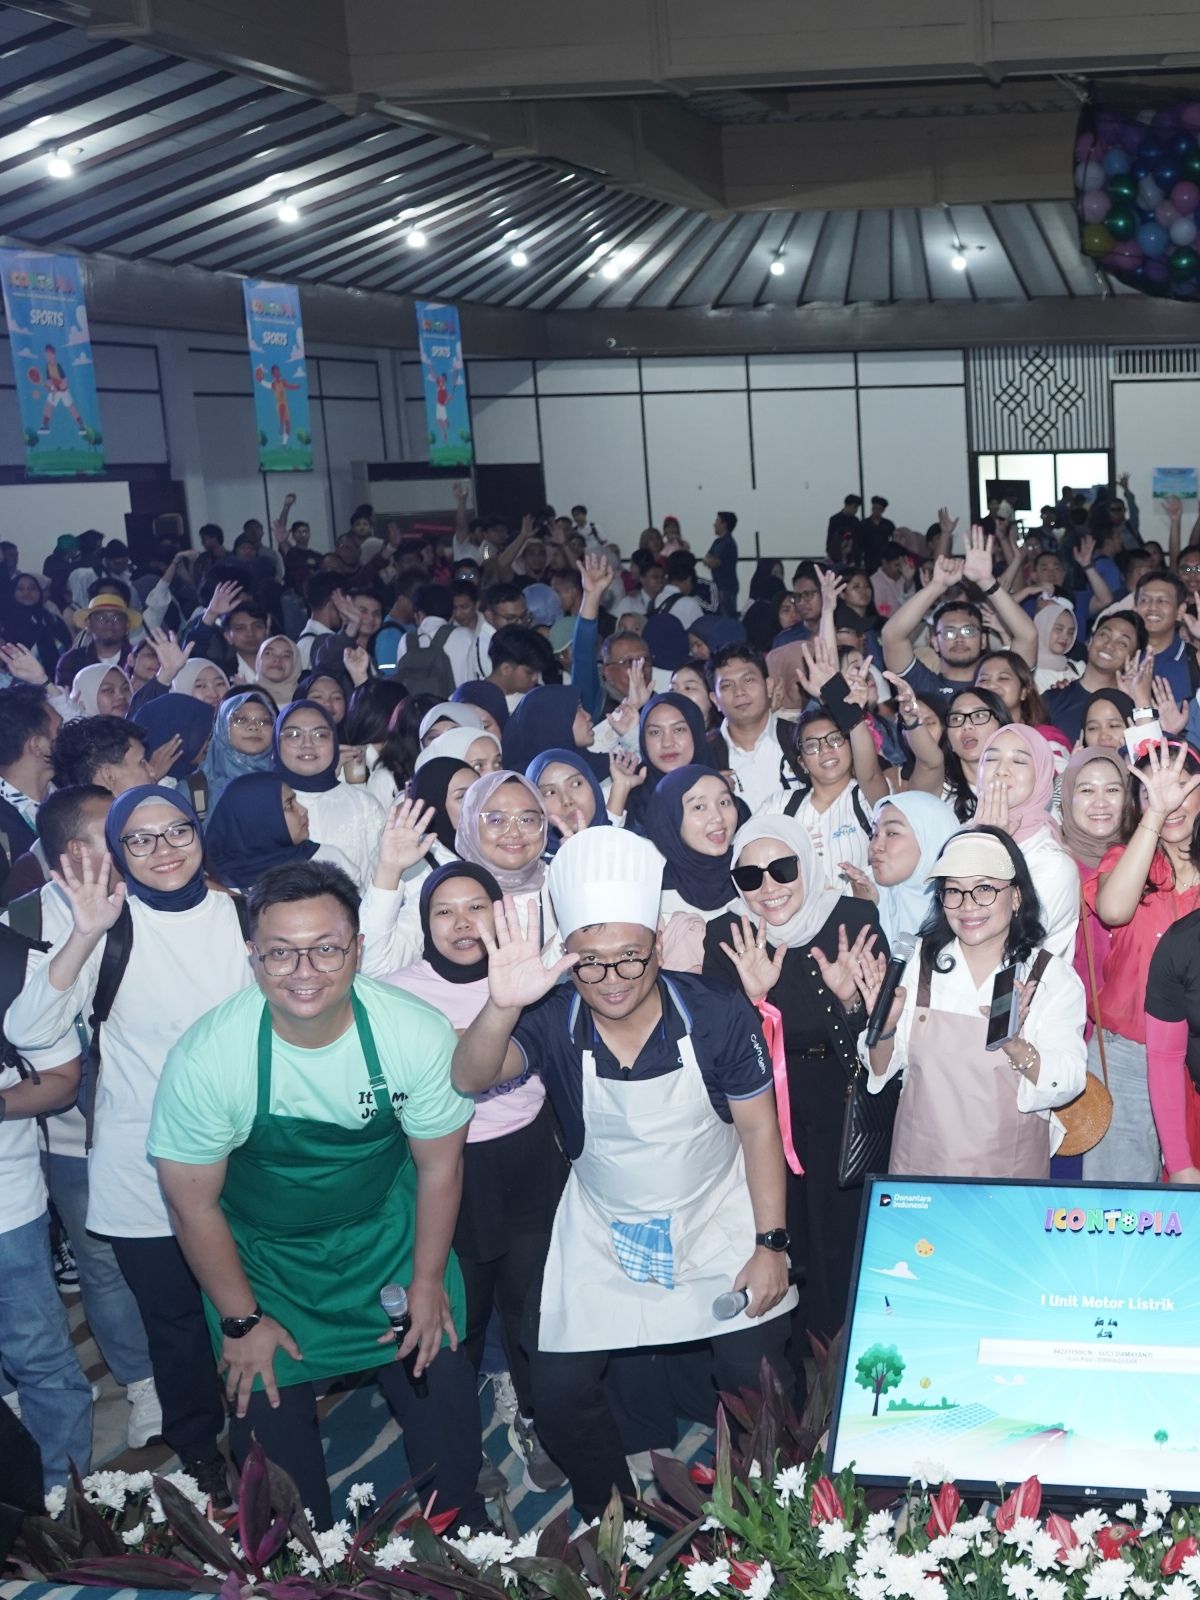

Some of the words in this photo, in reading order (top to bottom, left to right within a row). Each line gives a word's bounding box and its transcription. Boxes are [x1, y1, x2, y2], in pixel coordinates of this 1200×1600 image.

[30, 309, 65, 328] SPORTS
[262, 331, 288, 346] SPORTS
[894, 1194, 932, 1202] Danantara
[1044, 1207, 1183, 1237] ICONTOPIA
[1049, 1294, 1079, 1308] Unit
[1082, 1296, 1125, 1310] Motor
[1128, 1297, 1175, 1312] Listrik
[1115, 1351, 1153, 1359] DAMAYANTI
